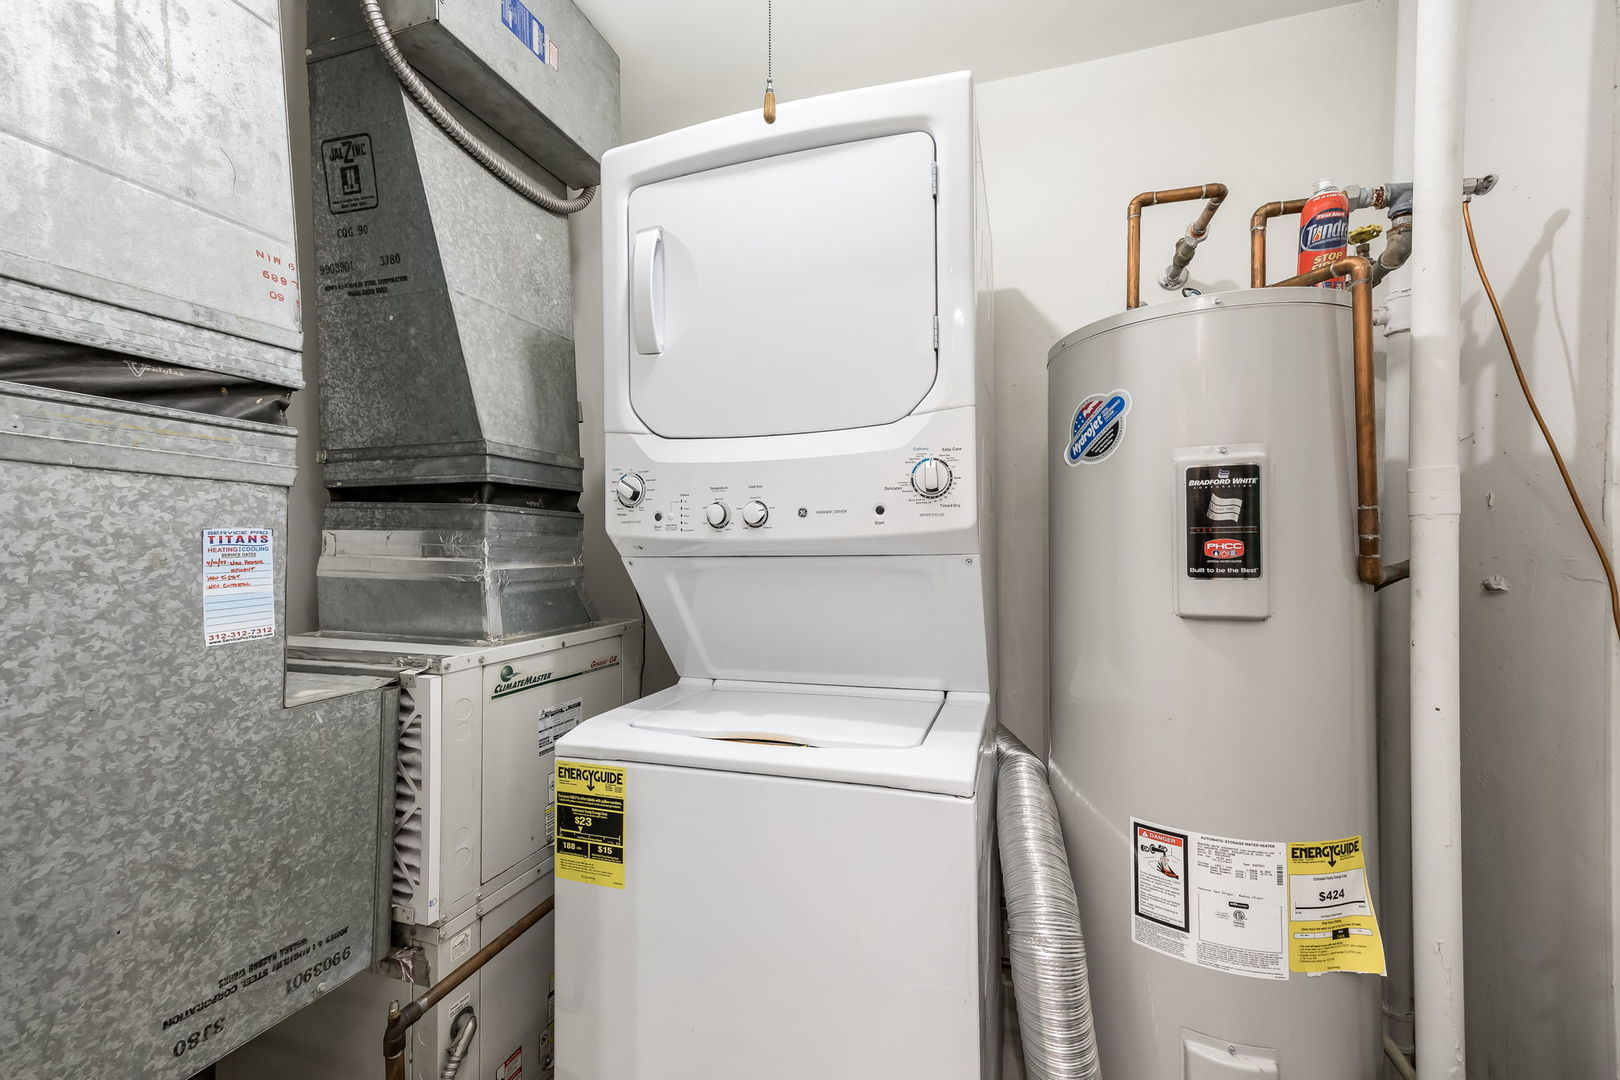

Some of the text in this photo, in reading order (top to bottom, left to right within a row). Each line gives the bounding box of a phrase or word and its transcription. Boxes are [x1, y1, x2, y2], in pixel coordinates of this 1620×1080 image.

[329, 141, 366, 163] JALZINC
[358, 224, 368, 236] 90
[1314, 252, 1343, 264] STOP
[1072, 414, 1103, 455] Hydrojet
[208, 536, 268, 544] TITANS
[208, 627, 273, 640] 312-312-7312
[558, 767, 623, 786] ENERGYGUIDE
[575, 816, 592, 826] $23
[1150, 832, 1176, 844] DANGER
[598, 846, 612, 854] $15
[1292, 841, 1359, 858] ENERGYGUIDE
[1319, 889, 1344, 902] $424
[285, 946, 351, 994] 9903901
[242, 969, 269, 988] STEEL
[162, 985, 237, 1031] CORPORATION
[173, 1017, 226, 1057] 3J80
